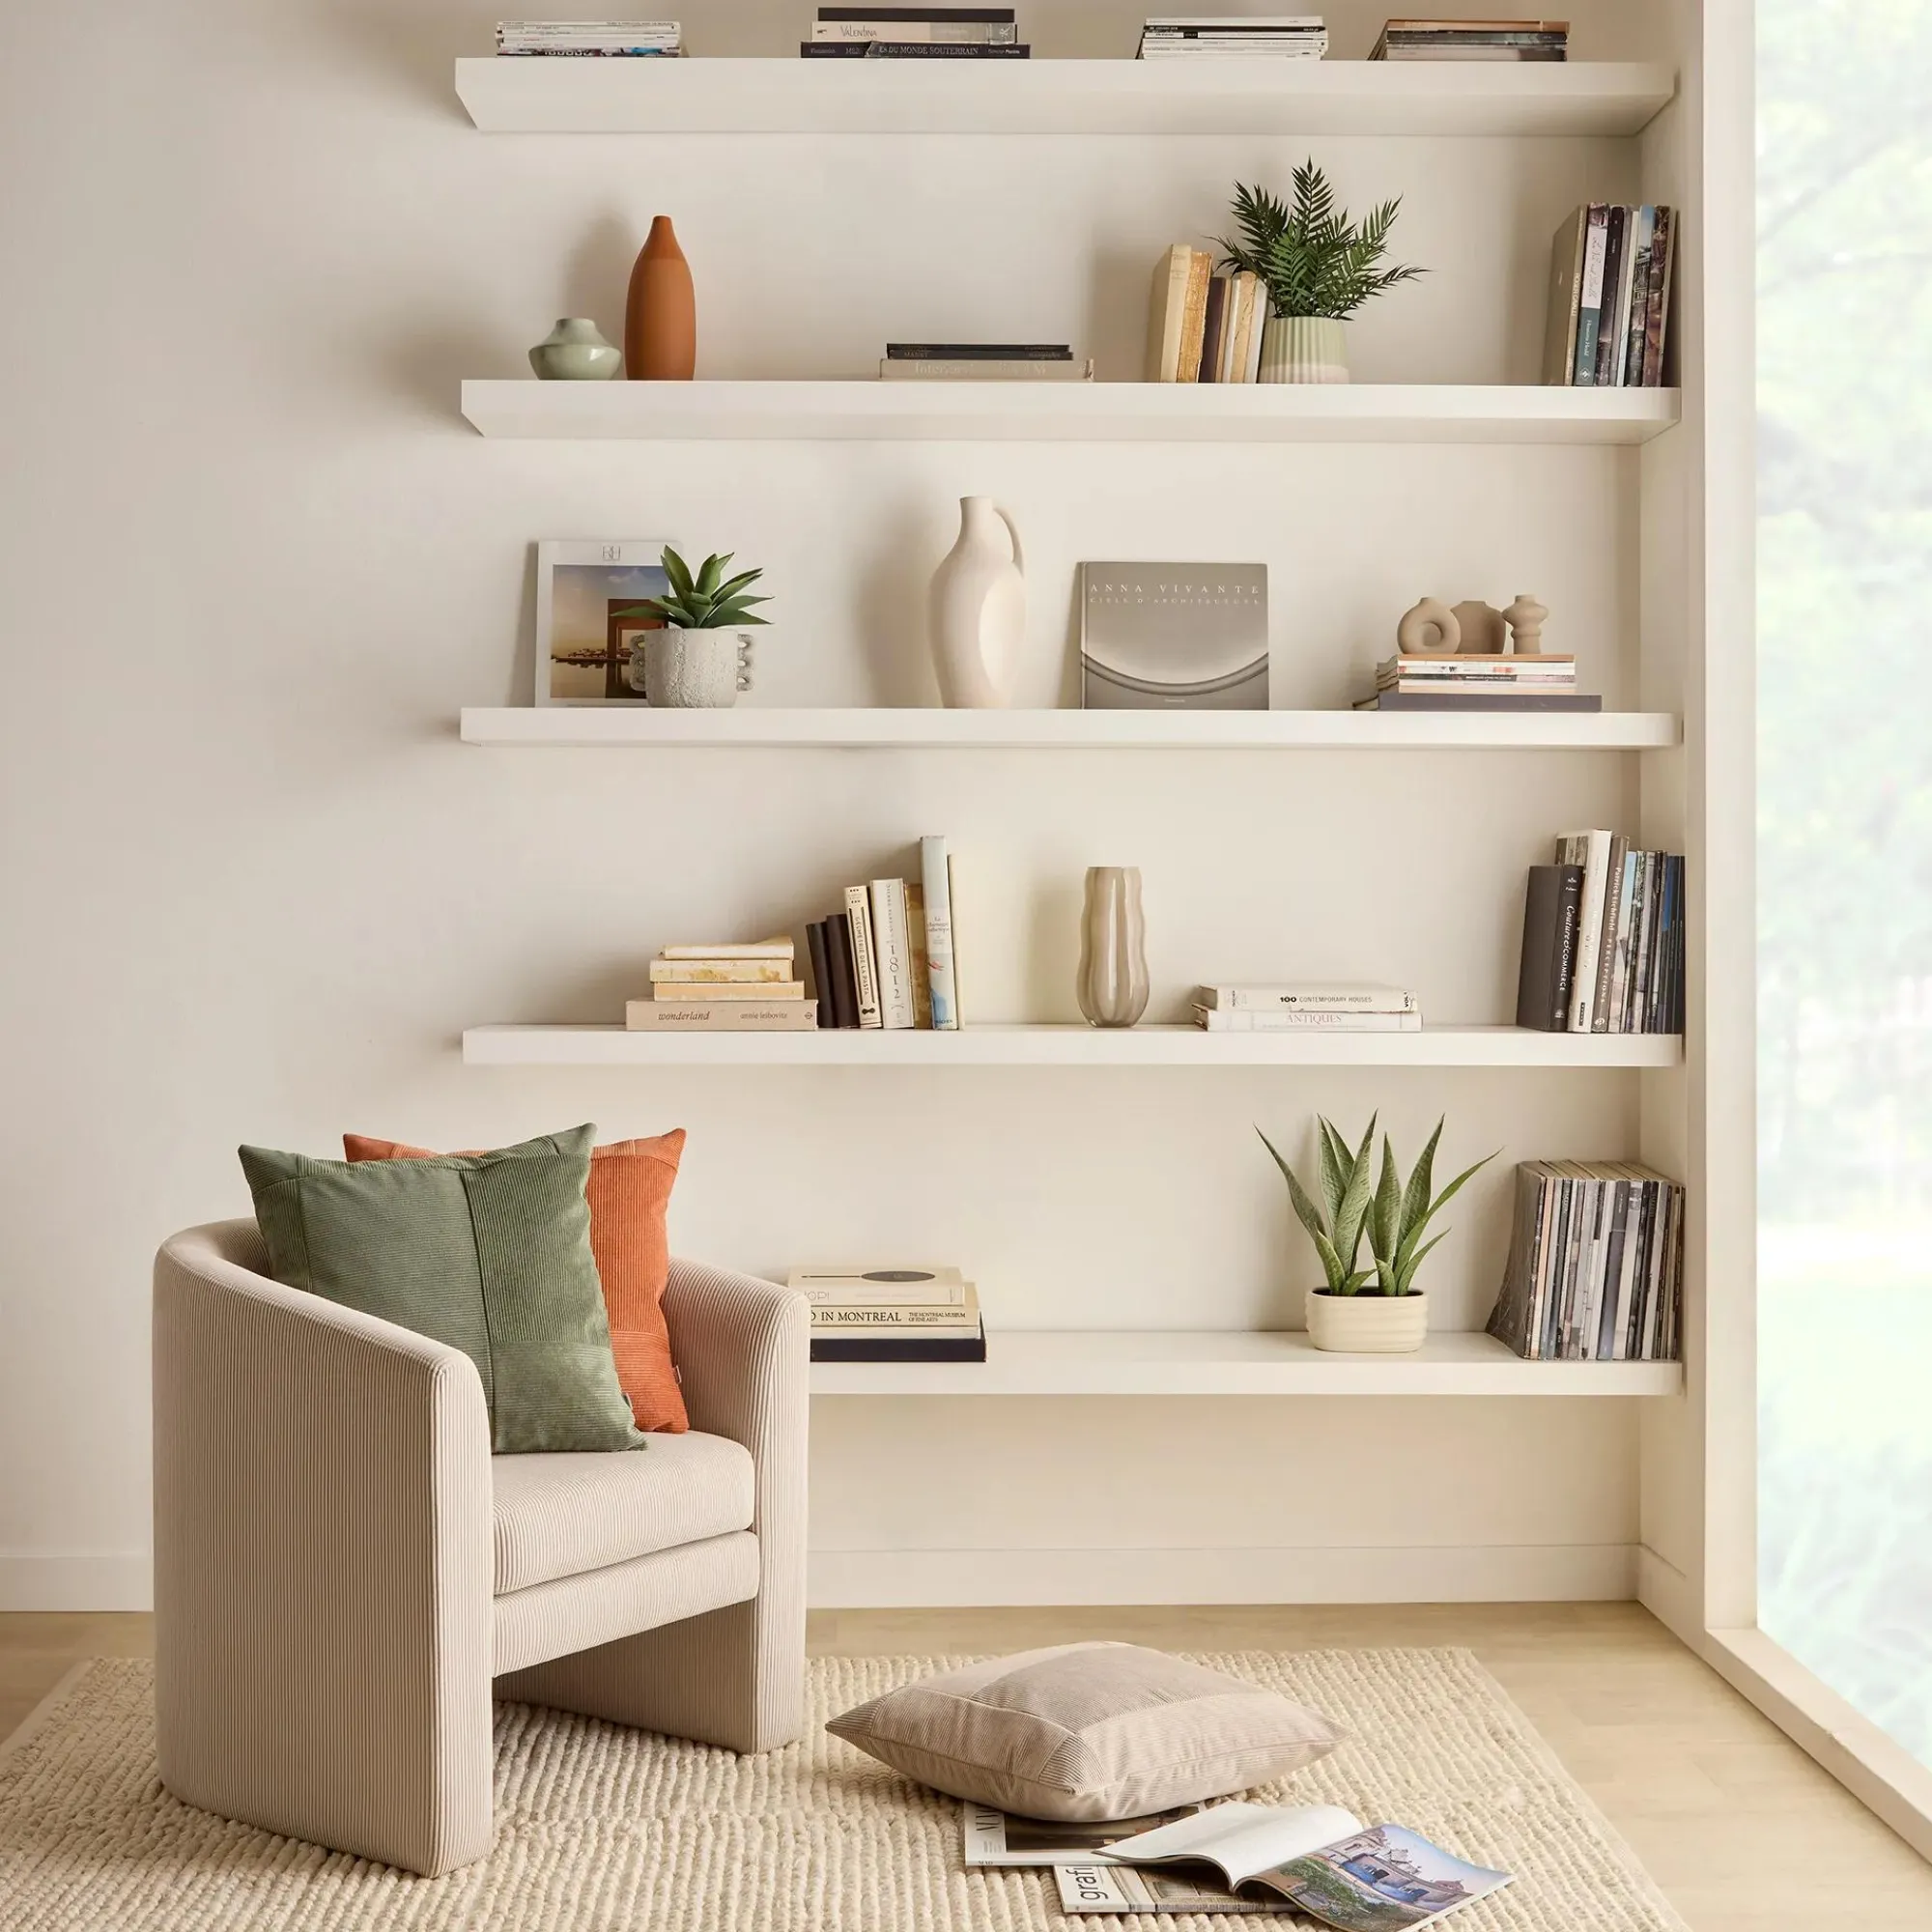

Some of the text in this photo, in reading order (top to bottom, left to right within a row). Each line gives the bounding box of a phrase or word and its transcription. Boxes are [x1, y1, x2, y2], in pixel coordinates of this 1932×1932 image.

[899, 45, 927, 55] MONDE
[929, 45, 979, 55] SOUTERRAIN
[1090, 583, 1259, 594] ANNA VIVANTE
[1613, 867, 1622, 895] Patrick
[860, 954, 867, 964] DE
[860, 965, 867, 975] LA
[1601, 937, 1612, 1004] PERCEPTIONS
[658, 1011, 710, 1021] wonderland
[1287, 1014, 1342, 1024] ANTIQUES
[821, 1312, 834, 1321] IN
[838, 1311, 902, 1321] MONTREAL
